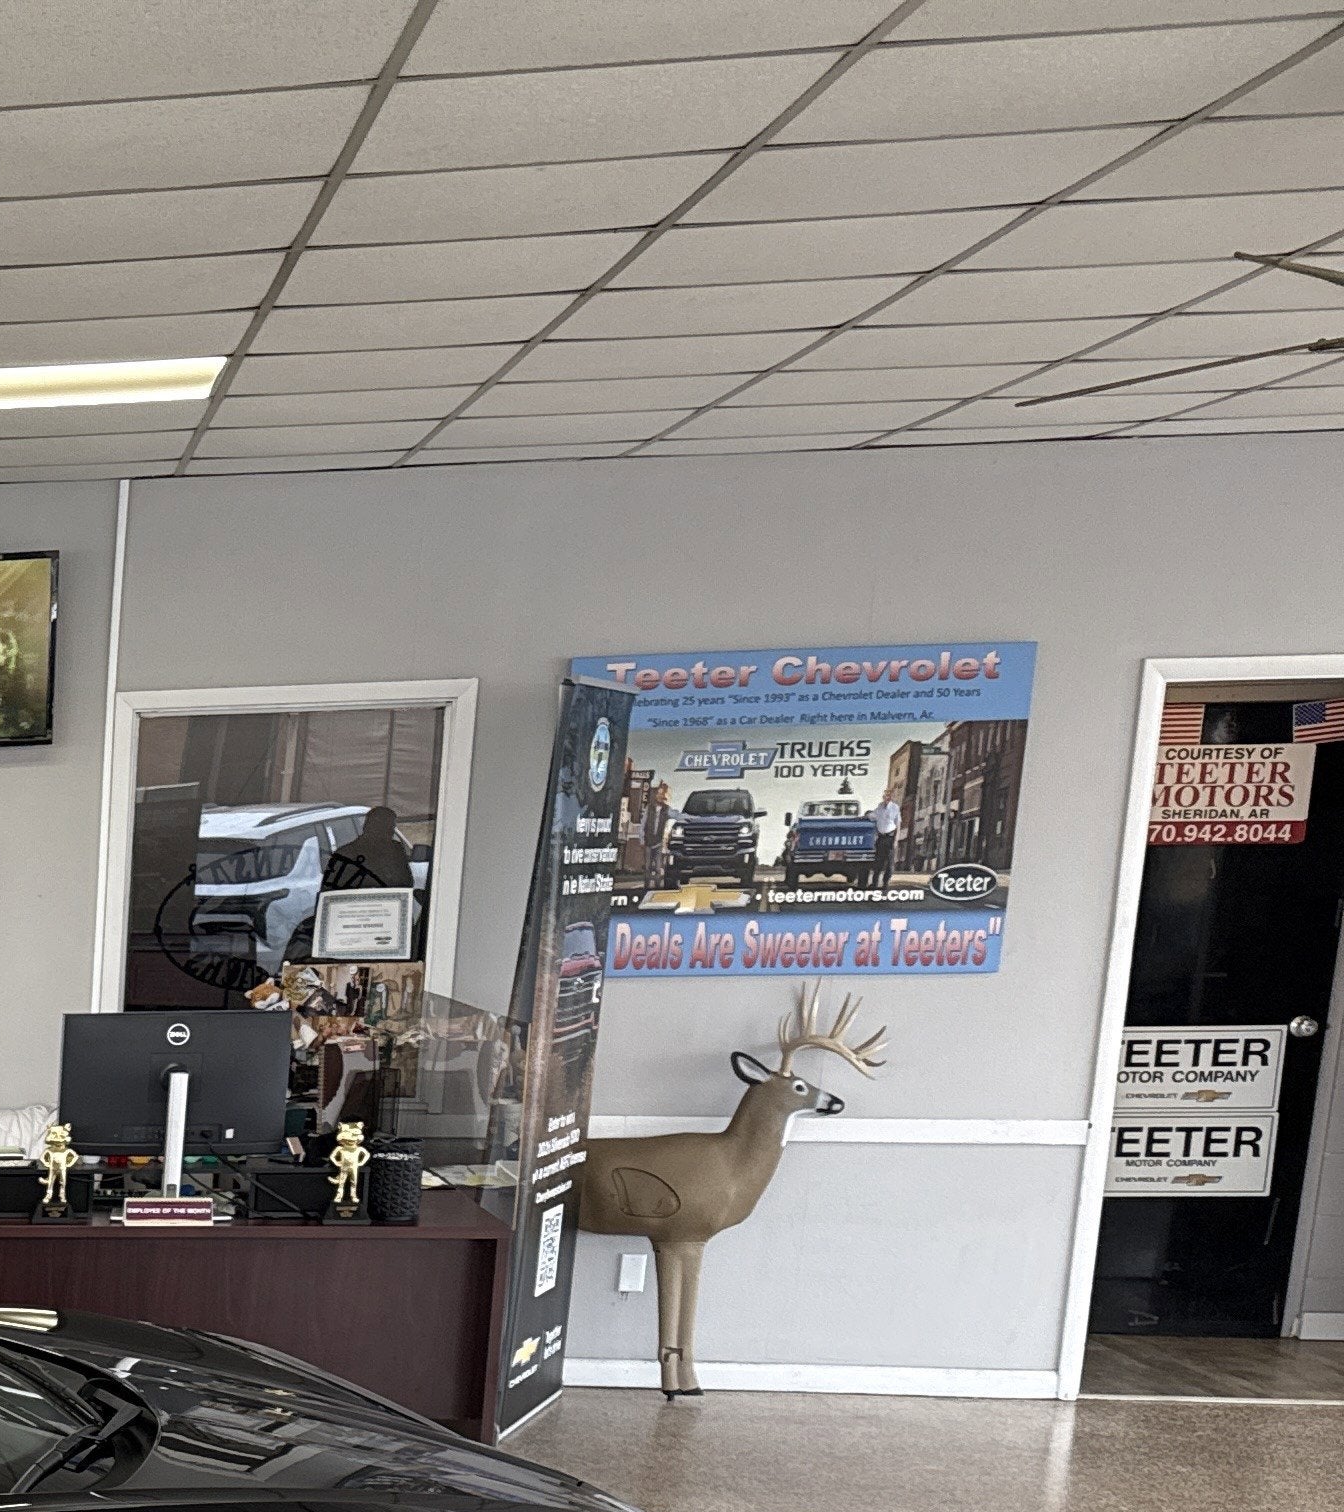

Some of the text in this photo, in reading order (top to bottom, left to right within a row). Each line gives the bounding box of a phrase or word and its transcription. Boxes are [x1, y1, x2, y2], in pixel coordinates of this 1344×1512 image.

[606, 650, 1002, 691] Teeter Chevrolet
[633, 695, 680, 709] lebrating
[682, 696, 696, 706] 25
[697, 696, 726, 708] years
[798, 693, 810, 702] as
[812, 693, 819, 701] a
[822, 691, 874, 701] Chevrolet
[876, 689, 911, 700] Dealer
[913, 687, 934, 698] and
[936, 688, 951, 698] 50
[953, 687, 982, 697] Years
[716, 718, 728, 727] as
[739, 715, 758, 725] Car
[759, 713, 795, 725] Dealer
[800, 711, 828, 724] Right
[830, 711, 854, 722] here
[856, 711, 868, 721] in
[685, 739, 872, 768] CHEVROLET TRUCKS
[1165, 747, 1285, 761] COURTESY OF
[774, 763, 869, 779] 100 YEARS
[1156, 761, 1291, 785] TEETER
[1151, 784, 1295, 808] MOTORS
[1248, 808, 1270, 819] AR
[1149, 823, 1292, 843] 70.942.8044
[937, 871, 994, 892] Teeter
[767, 886, 925, 904] teetermotors.com
[614, 921, 683, 971] Deals
[689, 920, 735, 970] Are
[743, 919, 849, 969] Sweeter
[854, 920, 883, 968] at
[1121, 1038, 1271, 1068] EETER
[1117, 1070, 1260, 1083] OTOR COMPANY
[1112, 1126, 1263, 1158] EETER
[1125, 1159, 1218, 1167] MOTOR COMPANY
